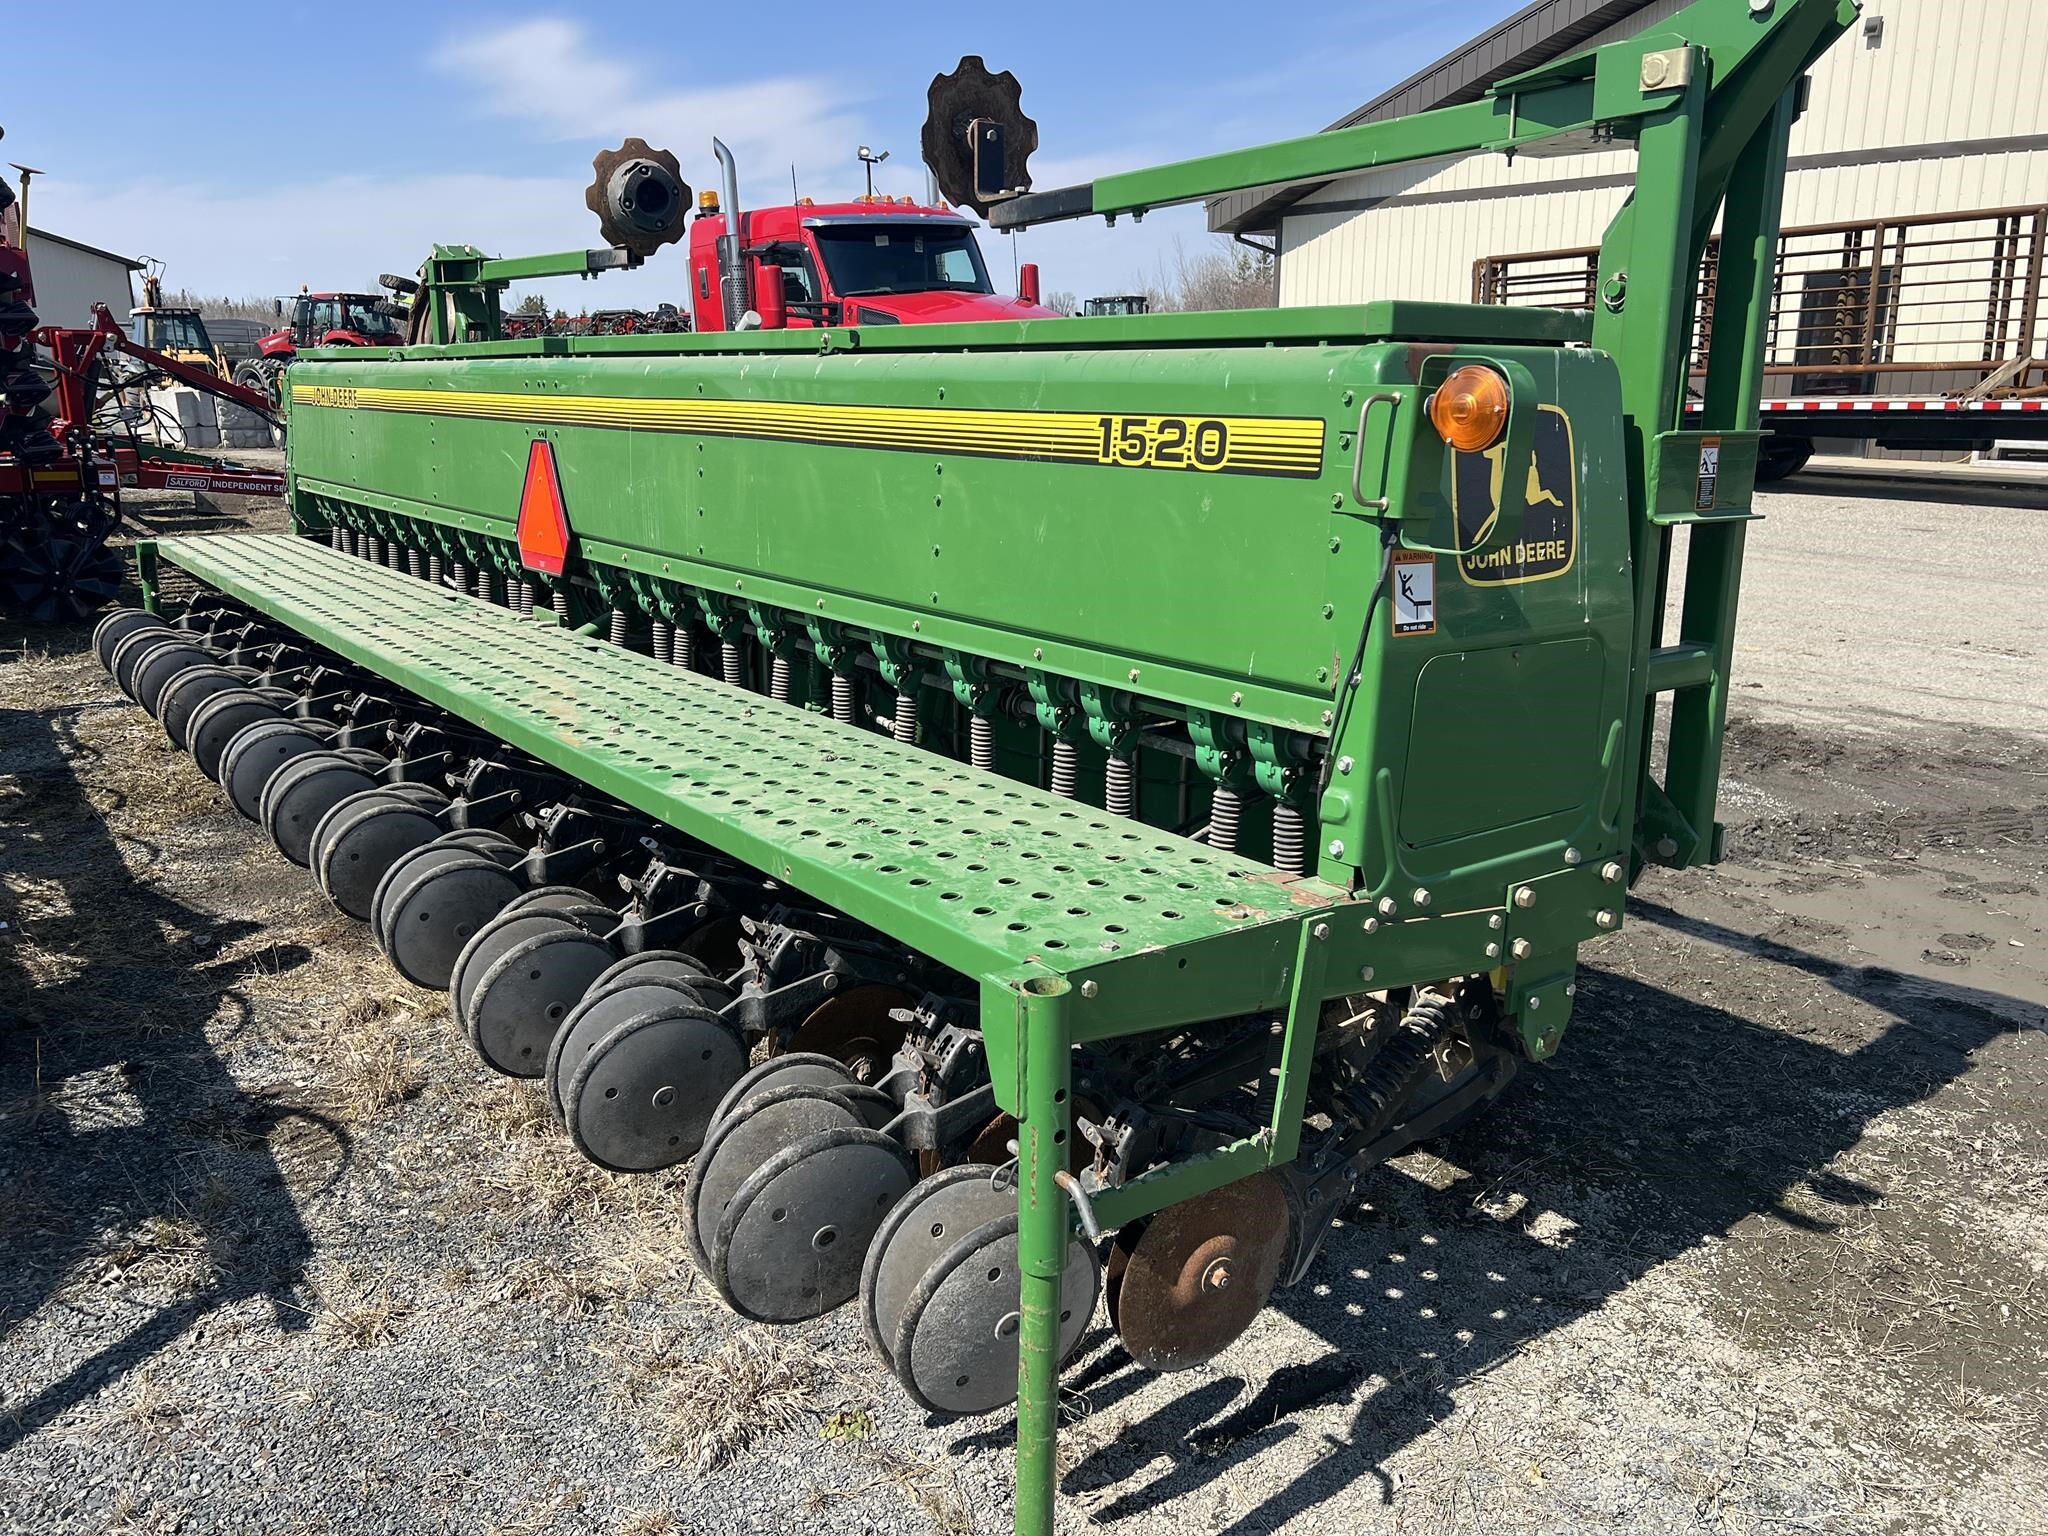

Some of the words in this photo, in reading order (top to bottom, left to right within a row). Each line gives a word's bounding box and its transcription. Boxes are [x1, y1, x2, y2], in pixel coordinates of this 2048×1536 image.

[312, 387, 331, 406] JOHN
[333, 388, 358, 408] DEERE
[1098, 417, 1228, 466] 1520
[169, 477, 207, 488] SALFORD
[212, 480, 273, 492] INDEPENDENT
[1402, 552, 1433, 561] WARNING
[1466, 545, 1511, 570] JOHN
[1515, 540, 1566, 564] DEERE
